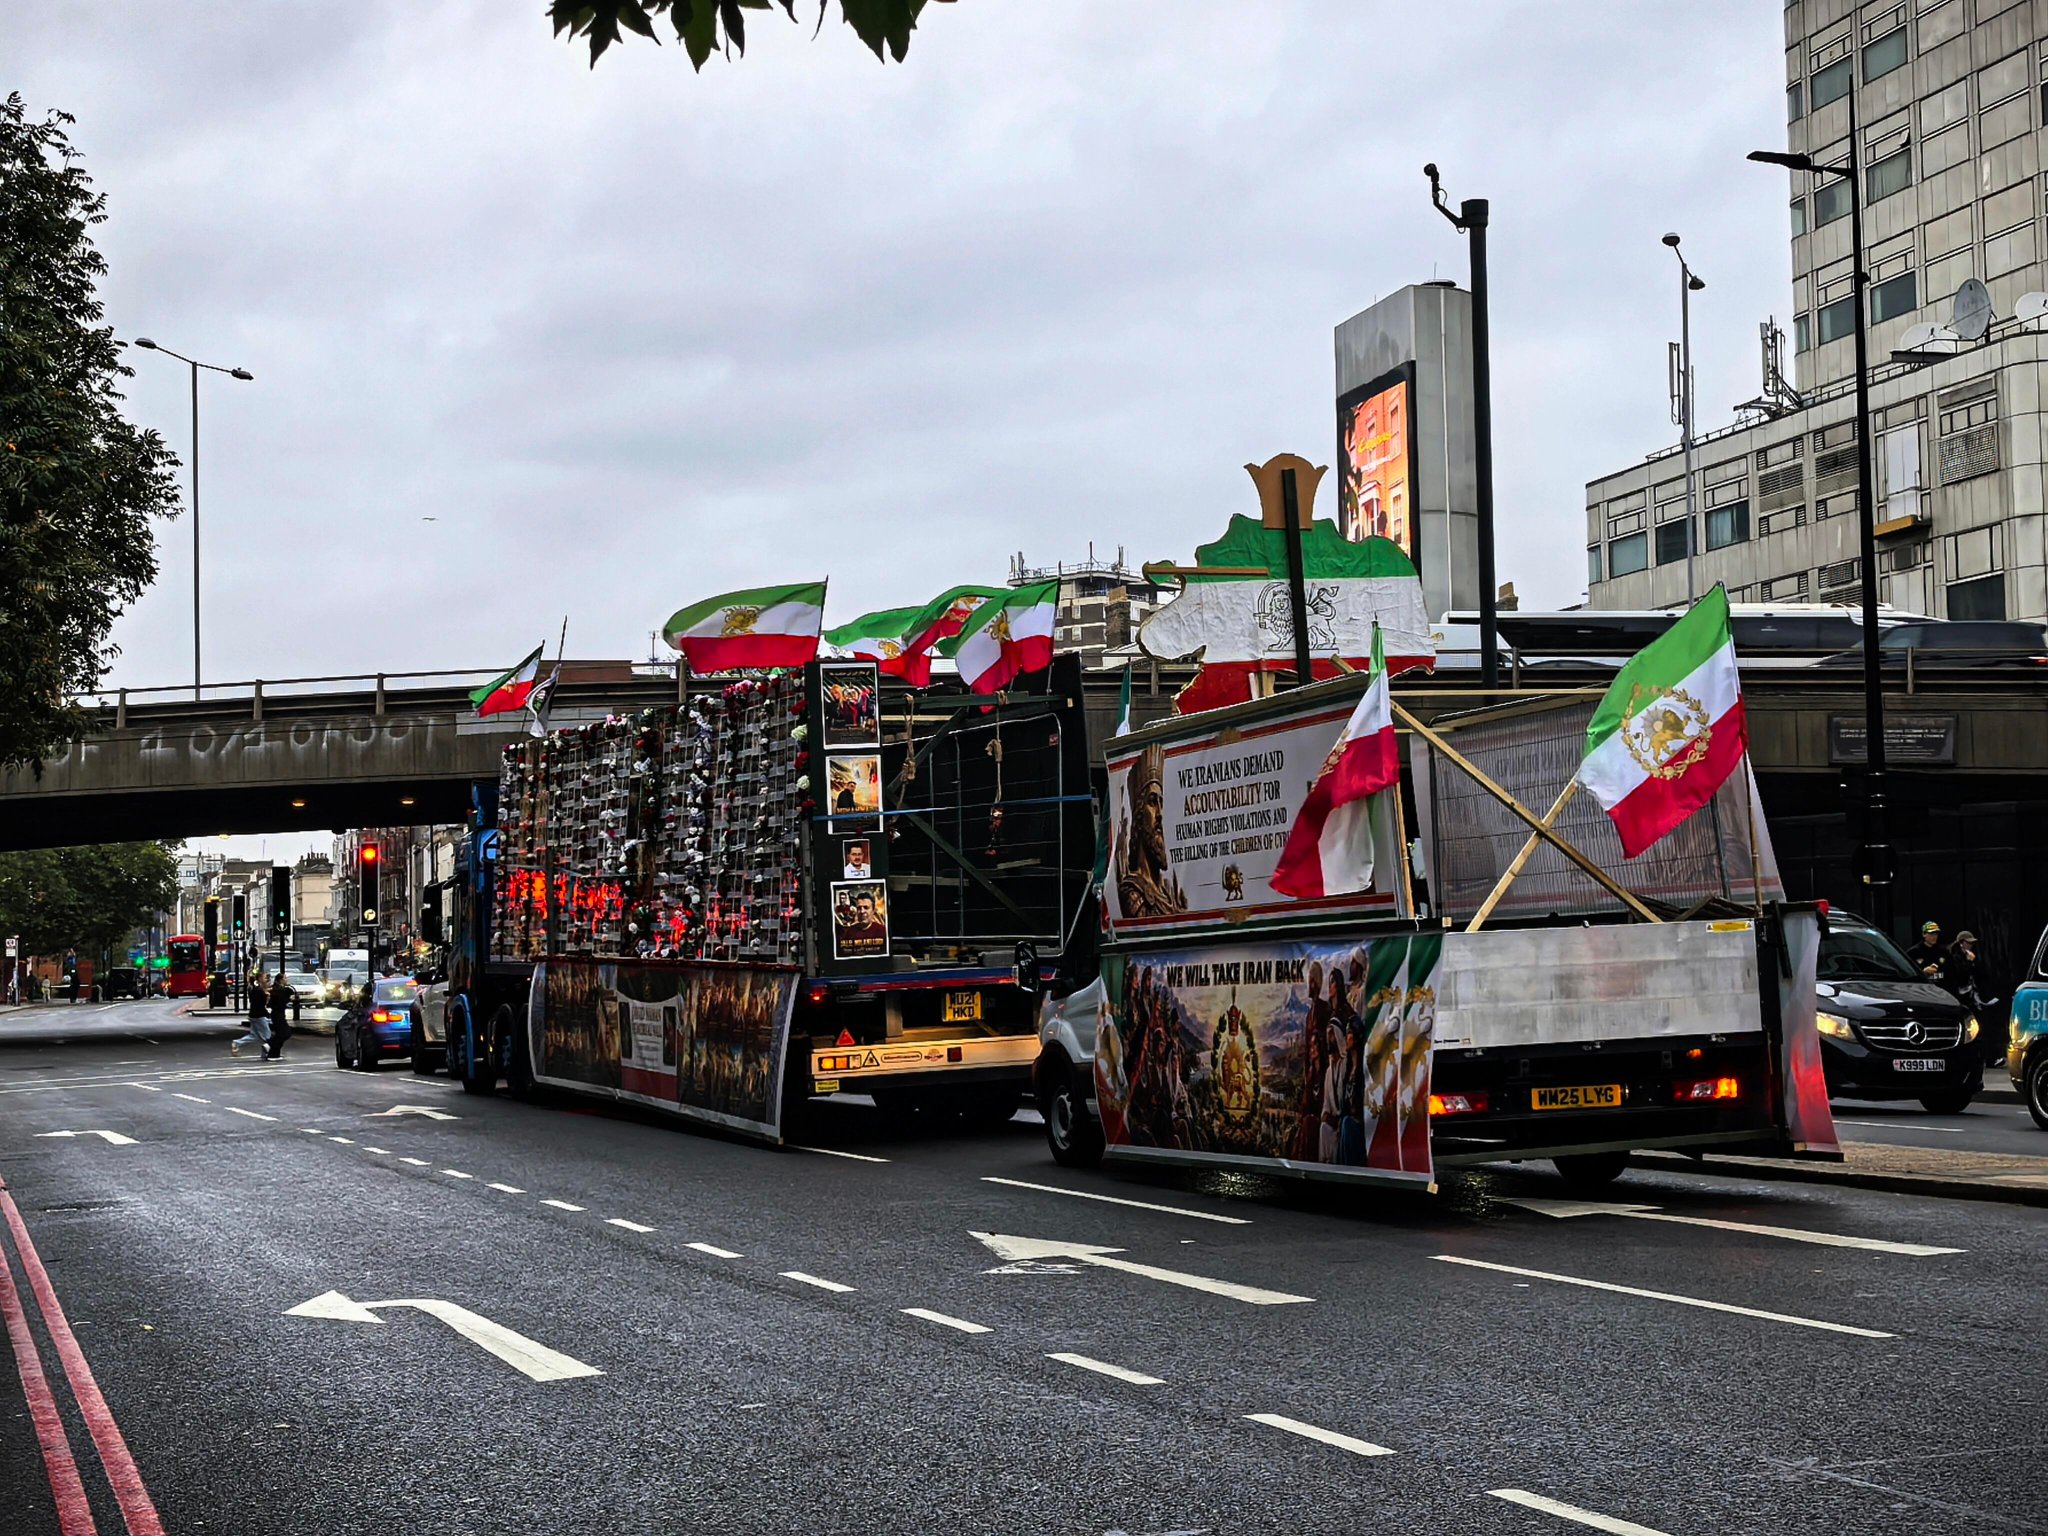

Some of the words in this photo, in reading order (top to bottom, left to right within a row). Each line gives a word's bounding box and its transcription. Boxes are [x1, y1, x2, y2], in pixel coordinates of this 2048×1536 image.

[1178, 769, 1193, 789] WE
[1195, 758, 1243, 786] IRANIANS
[1244, 750, 1284, 777] DEMAND
[1184, 782, 1262, 817] ACCOUNTABILITY
[1264, 780, 1280, 801] FOR
[1176, 822, 1203, 840] HUMAN
[1204, 816, 1229, 837] RIGHTS
[1230, 809, 1272, 832] VIOLATIONS
[1272, 807, 1287, 826] AND
[1169, 848, 1184, 864] THE
[1184, 844, 1208, 862] KILLING
[1209, 843, 1218, 857] OF
[1218, 840, 1230, 855] THE
[1231, 834, 1263, 854] CHILDREN
[1264, 834, 1273, 850] OF
[1167, 966, 1183, 988] WE
[1185, 964, 1210, 987] WILL
[1212, 962, 1241, 986] TAKE
[1243, 960, 1272, 985] IRAN
[1275, 959, 1306, 984] BACK
[1899, 1060, 1925, 1070] K999
[1926, 1060, 1944, 1070] LDN
[1583, 1086, 1614, 1104] LYG
